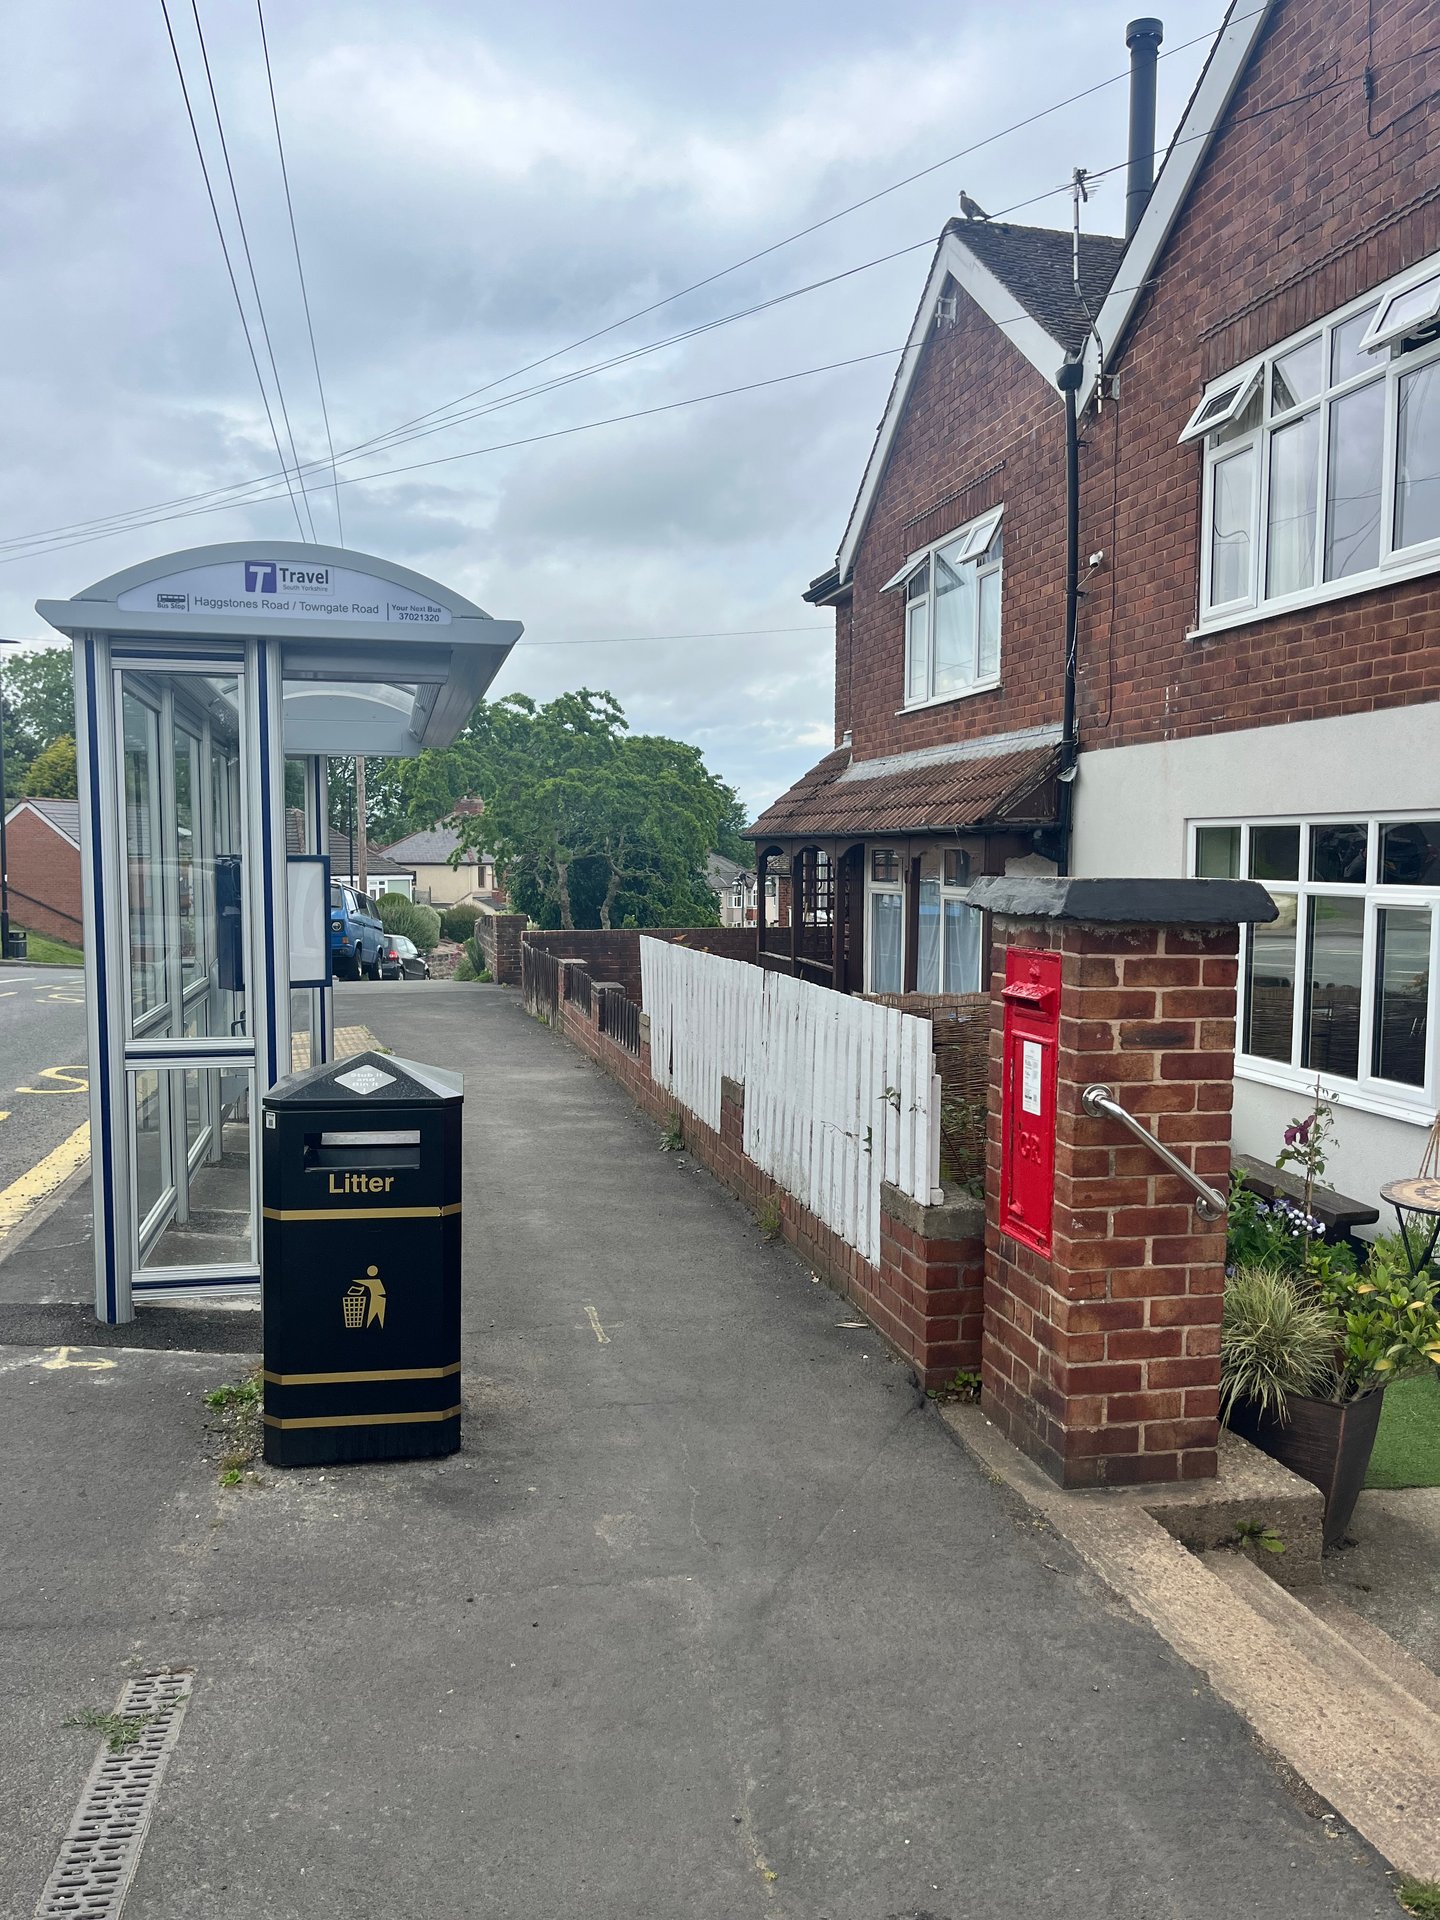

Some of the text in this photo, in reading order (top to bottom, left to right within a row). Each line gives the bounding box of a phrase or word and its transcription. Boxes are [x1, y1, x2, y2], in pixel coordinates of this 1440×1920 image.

[279, 568, 329, 585] Travel
[194, 596, 379, 614] Haggstones Road / Towngate Road
[392, 604, 408, 612] Your
[398, 612, 440, 622] 37021320
[329, 1173, 395, 1194] Litter
